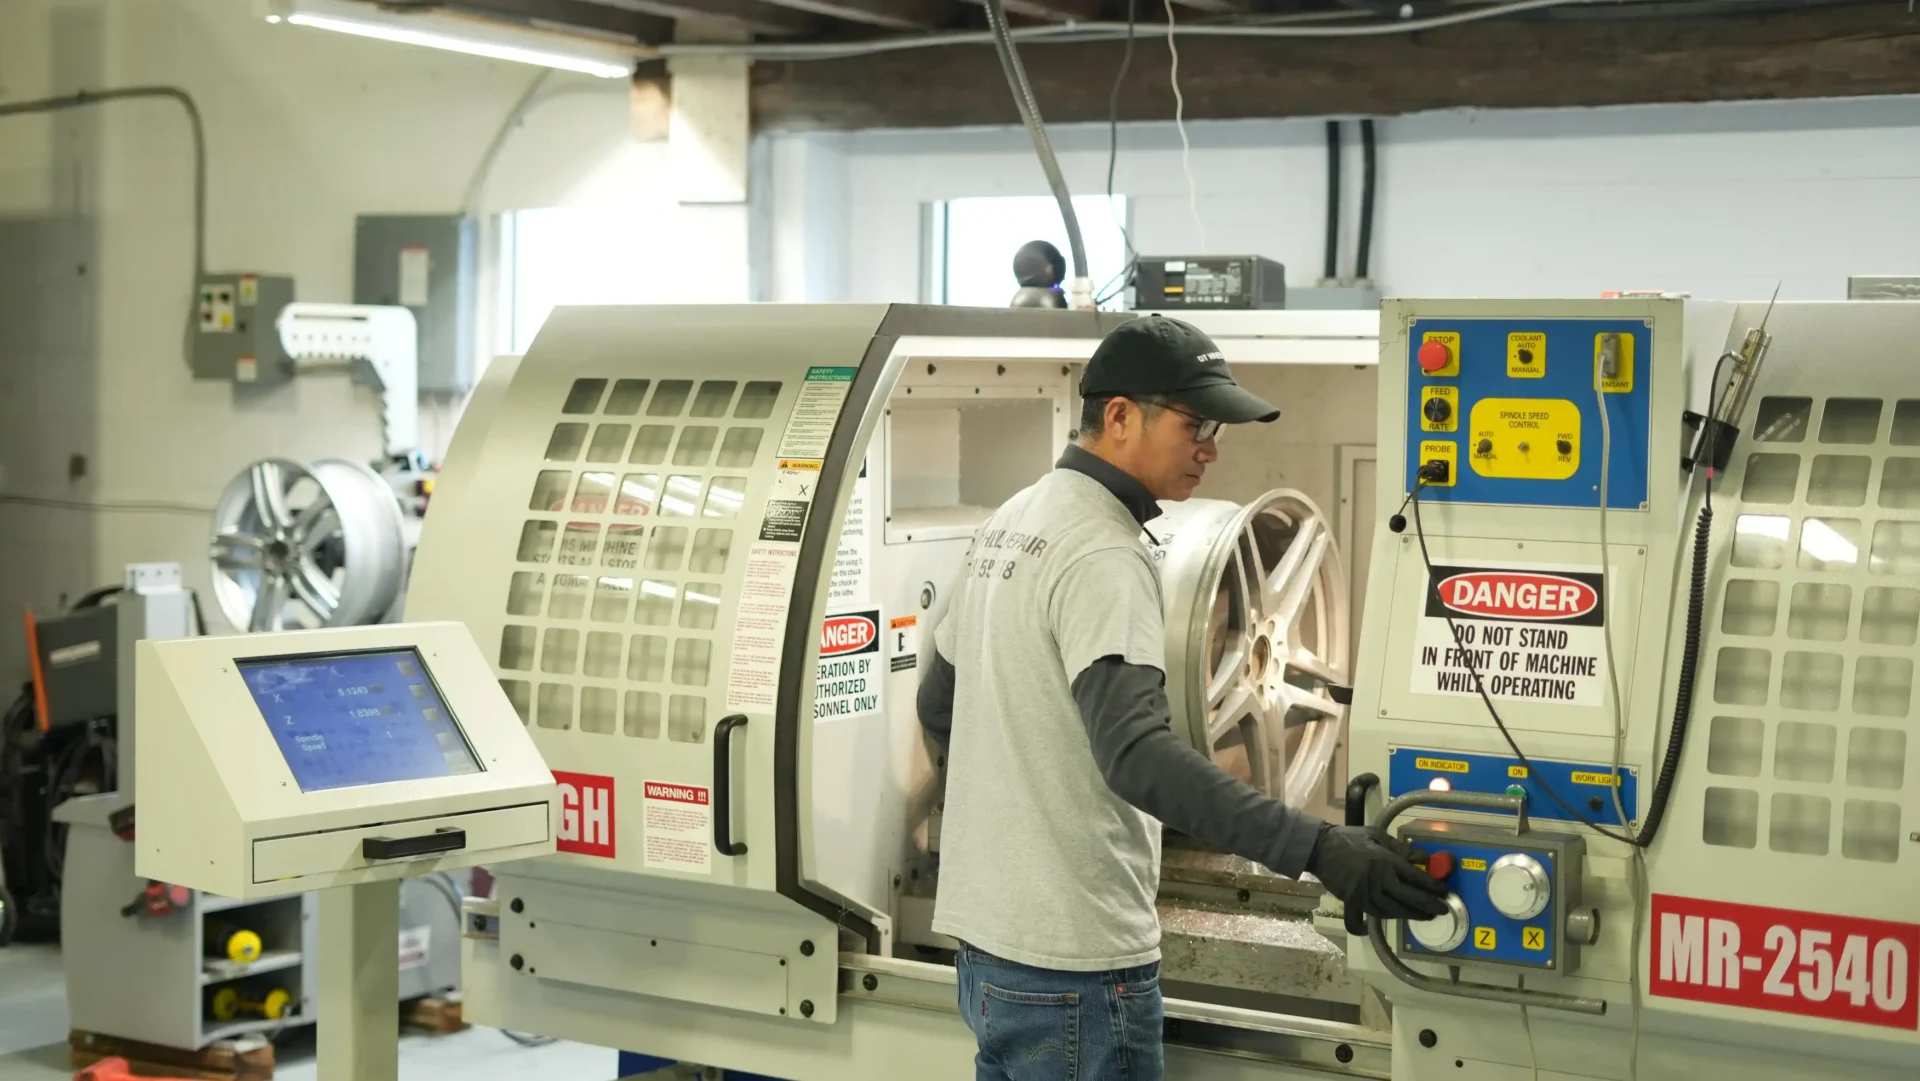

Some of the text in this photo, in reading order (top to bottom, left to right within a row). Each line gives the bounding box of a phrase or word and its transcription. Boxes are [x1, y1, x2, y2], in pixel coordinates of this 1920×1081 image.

[1511, 366, 1541, 374] MANUAL
[1430, 387, 1450, 396] FEED
[1499, 411, 1549, 420] SPINDLE SPEED
[1429, 423, 1450, 431] RATE
[1509, 421, 1540, 429] CONTROL
[1425, 445, 1452, 453] PROBE
[1473, 453, 1498, 461] MANUAL
[1558, 455, 1571, 463] REV
[1452, 579, 1581, 613] DANGER
[821, 622, 868, 648] ANGER
[1454, 624, 1568, 650] DO NOT STAND
[1422, 646, 1598, 677] IN FRONT OF MACHINE
[816, 660, 856, 680] ERATION
[859, 658, 871, 674] BY
[815, 678, 866, 699] UTHORIZED
[1437, 672, 1576, 700] WHILE OPERATING
[274, 693, 284, 702] X
[854, 694, 878, 712] ONLY
[284, 716, 294, 725] Z
[295, 734, 324, 743] Spindle
[302, 742, 327, 752] Speed
[1418, 760, 1466, 772] ON INDICATOR
[1512, 768, 1523, 776] ON
[1574, 774, 1596, 782] WORK
[647, 785, 694, 800] WARNING
[1462, 860, 1486, 868] ESTOP
[1480, 930, 1491, 946] Z
[1528, 931, 1540, 947] X
[1660, 912, 1908, 1012] MR-2540
